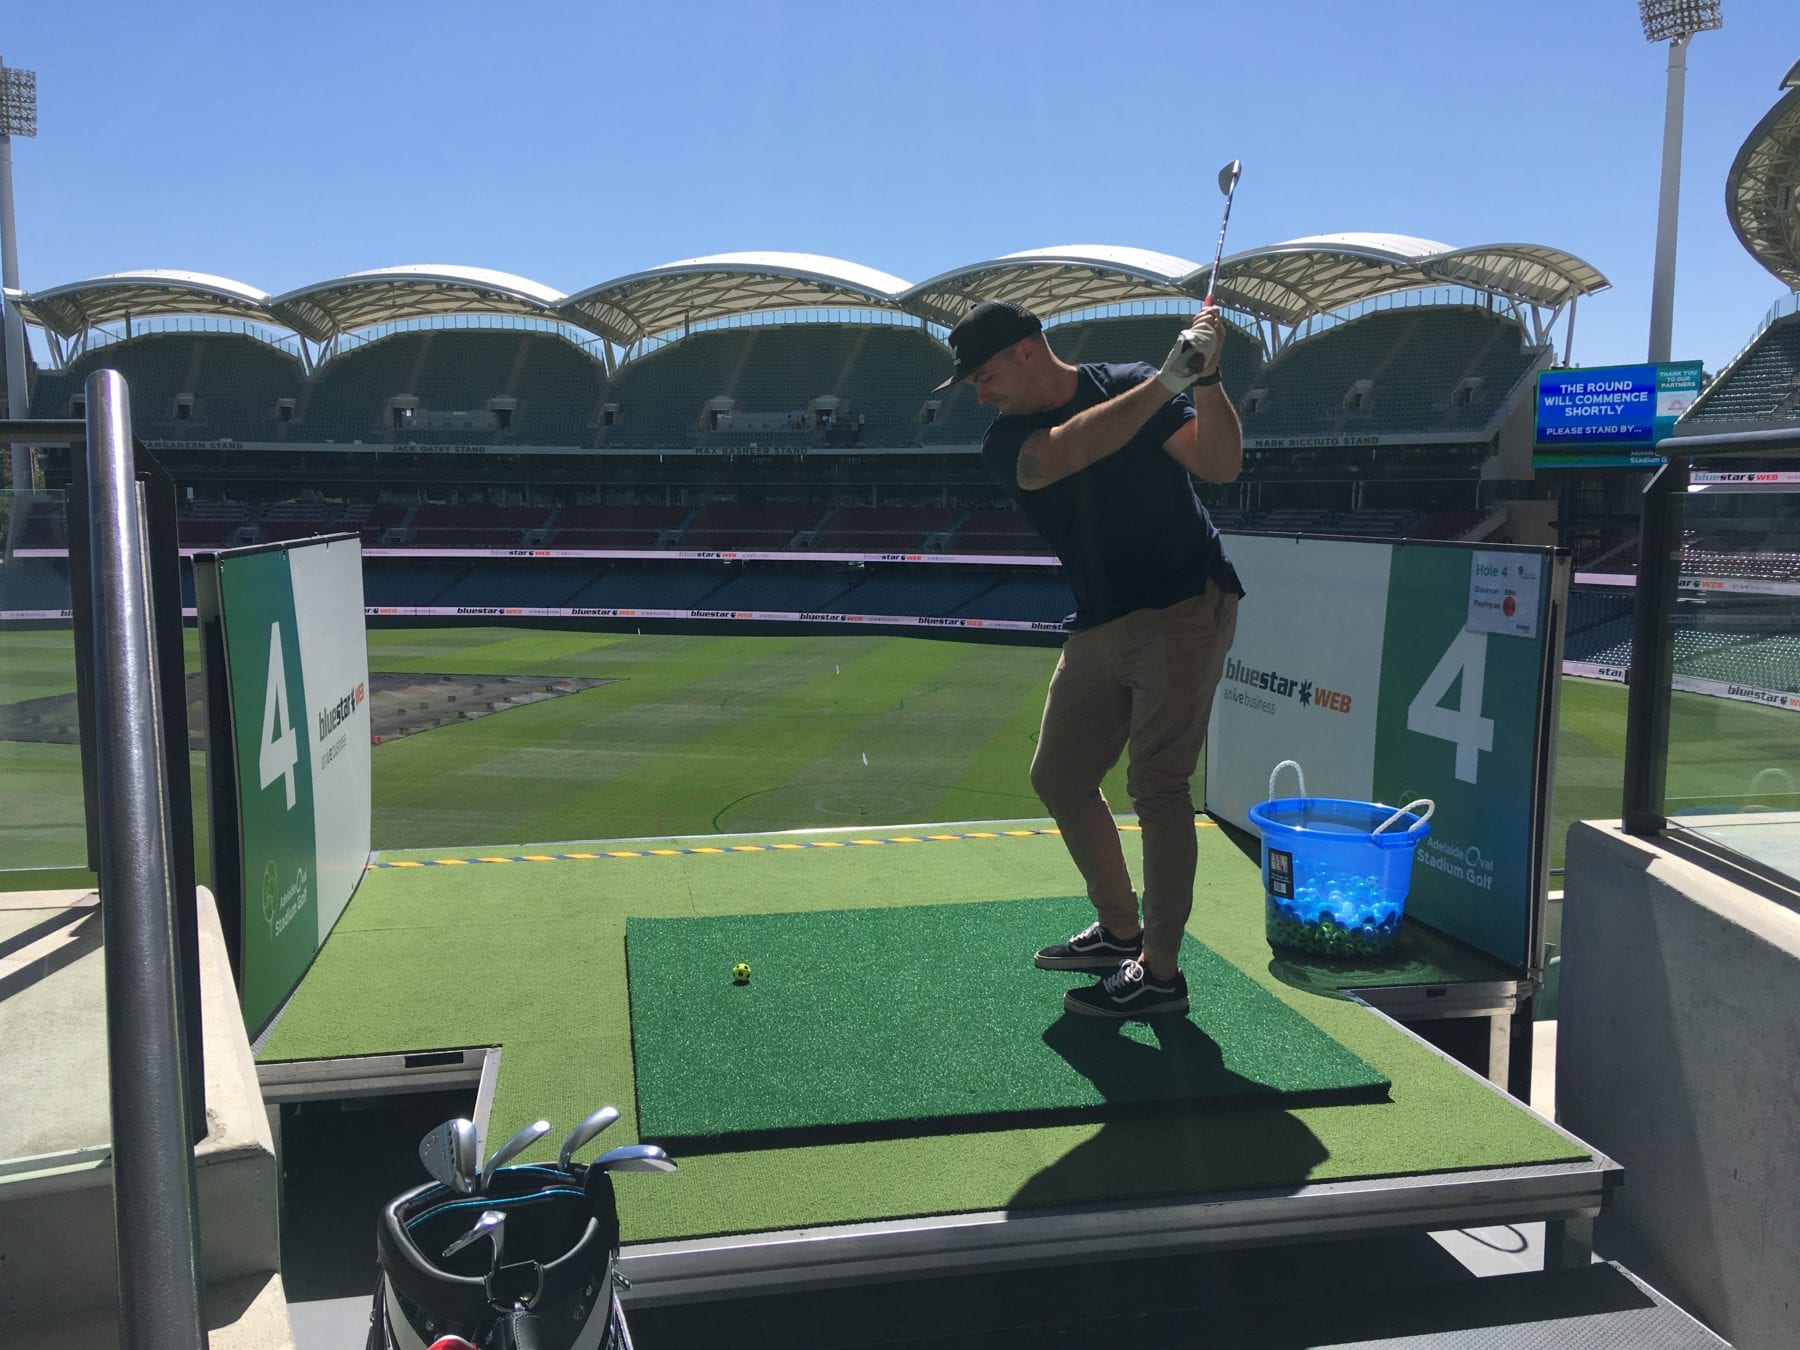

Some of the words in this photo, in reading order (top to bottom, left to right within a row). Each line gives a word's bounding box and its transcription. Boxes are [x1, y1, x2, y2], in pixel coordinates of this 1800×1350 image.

[1560, 384, 1584, 394] THE
[1587, 380, 1632, 393] ROUND
[1544, 396, 1573, 406] WILL
[1576, 392, 1648, 404] COMMENCE
[1565, 405, 1624, 417] SHORTLY
[1546, 427, 1583, 435] PLEASE
[1585, 426, 1618, 434] STAND
[1620, 425, 1642, 433] BY...
[210, 441, 244, 450] STAND
[1256, 440, 1284, 448] MARK
[1289, 438, 1339, 447] RICCIUTO
[1344, 436, 1379, 445] STAND
[695, 447, 718, 455] MAX
[774, 447, 807, 455] STAND
[1476, 564, 1499, 577] Hole
[1501, 566, 1508, 577] 4
[800, 613, 840, 621] bluestar
[918, 617, 959, 625] bluestar
[1032, 622, 1063, 630] bluest
[1225, 657, 1298, 698] bluestar
[1314, 687, 1352, 714] WEB
[1728, 686, 1779, 703] bluestar
[1406, 618, 1494, 785] 4
[258, 621, 298, 811] 4
[318, 694, 350, 743] bluestar
[354, 681, 364, 706] WEB
[1427, 836, 1464, 860] Adelaide
[1465, 846, 1494, 872] Oval
[1417, 848, 1464, 878] Stadium
[1466, 869, 1493, 890] Golf
